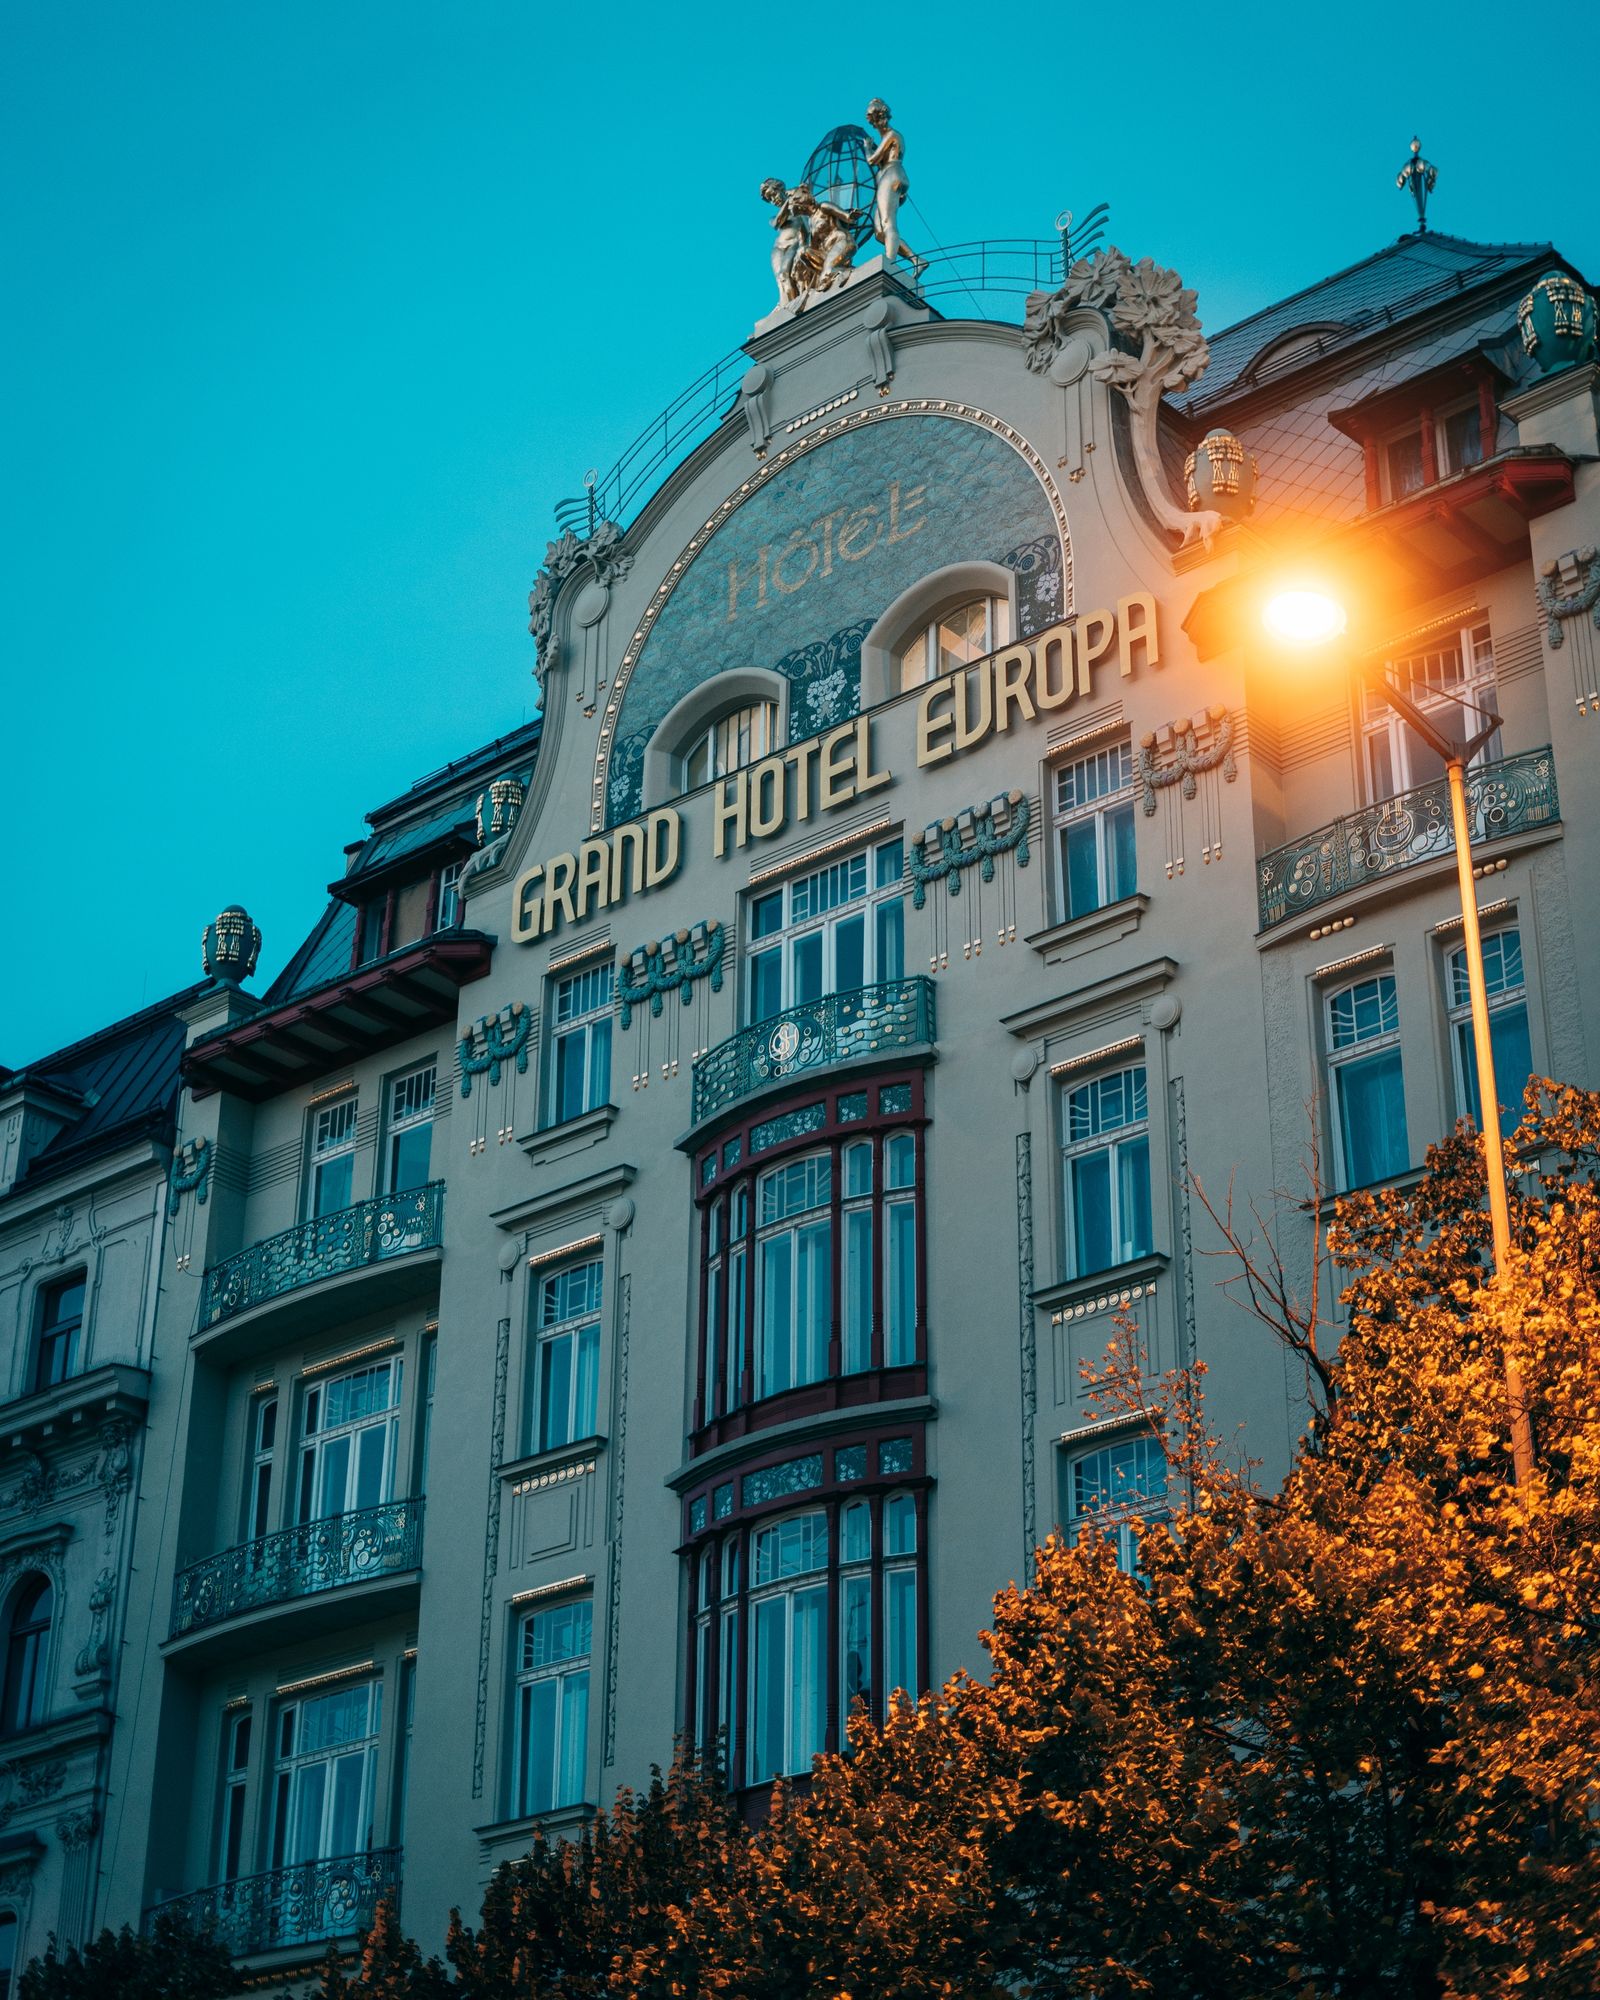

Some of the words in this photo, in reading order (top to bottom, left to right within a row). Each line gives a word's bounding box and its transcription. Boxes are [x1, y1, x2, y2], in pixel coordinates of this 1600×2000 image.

[512, 808, 681, 944] GRAND
[713, 715, 891, 858] HOTEL
[916, 593, 1160, 768] EUROPA
